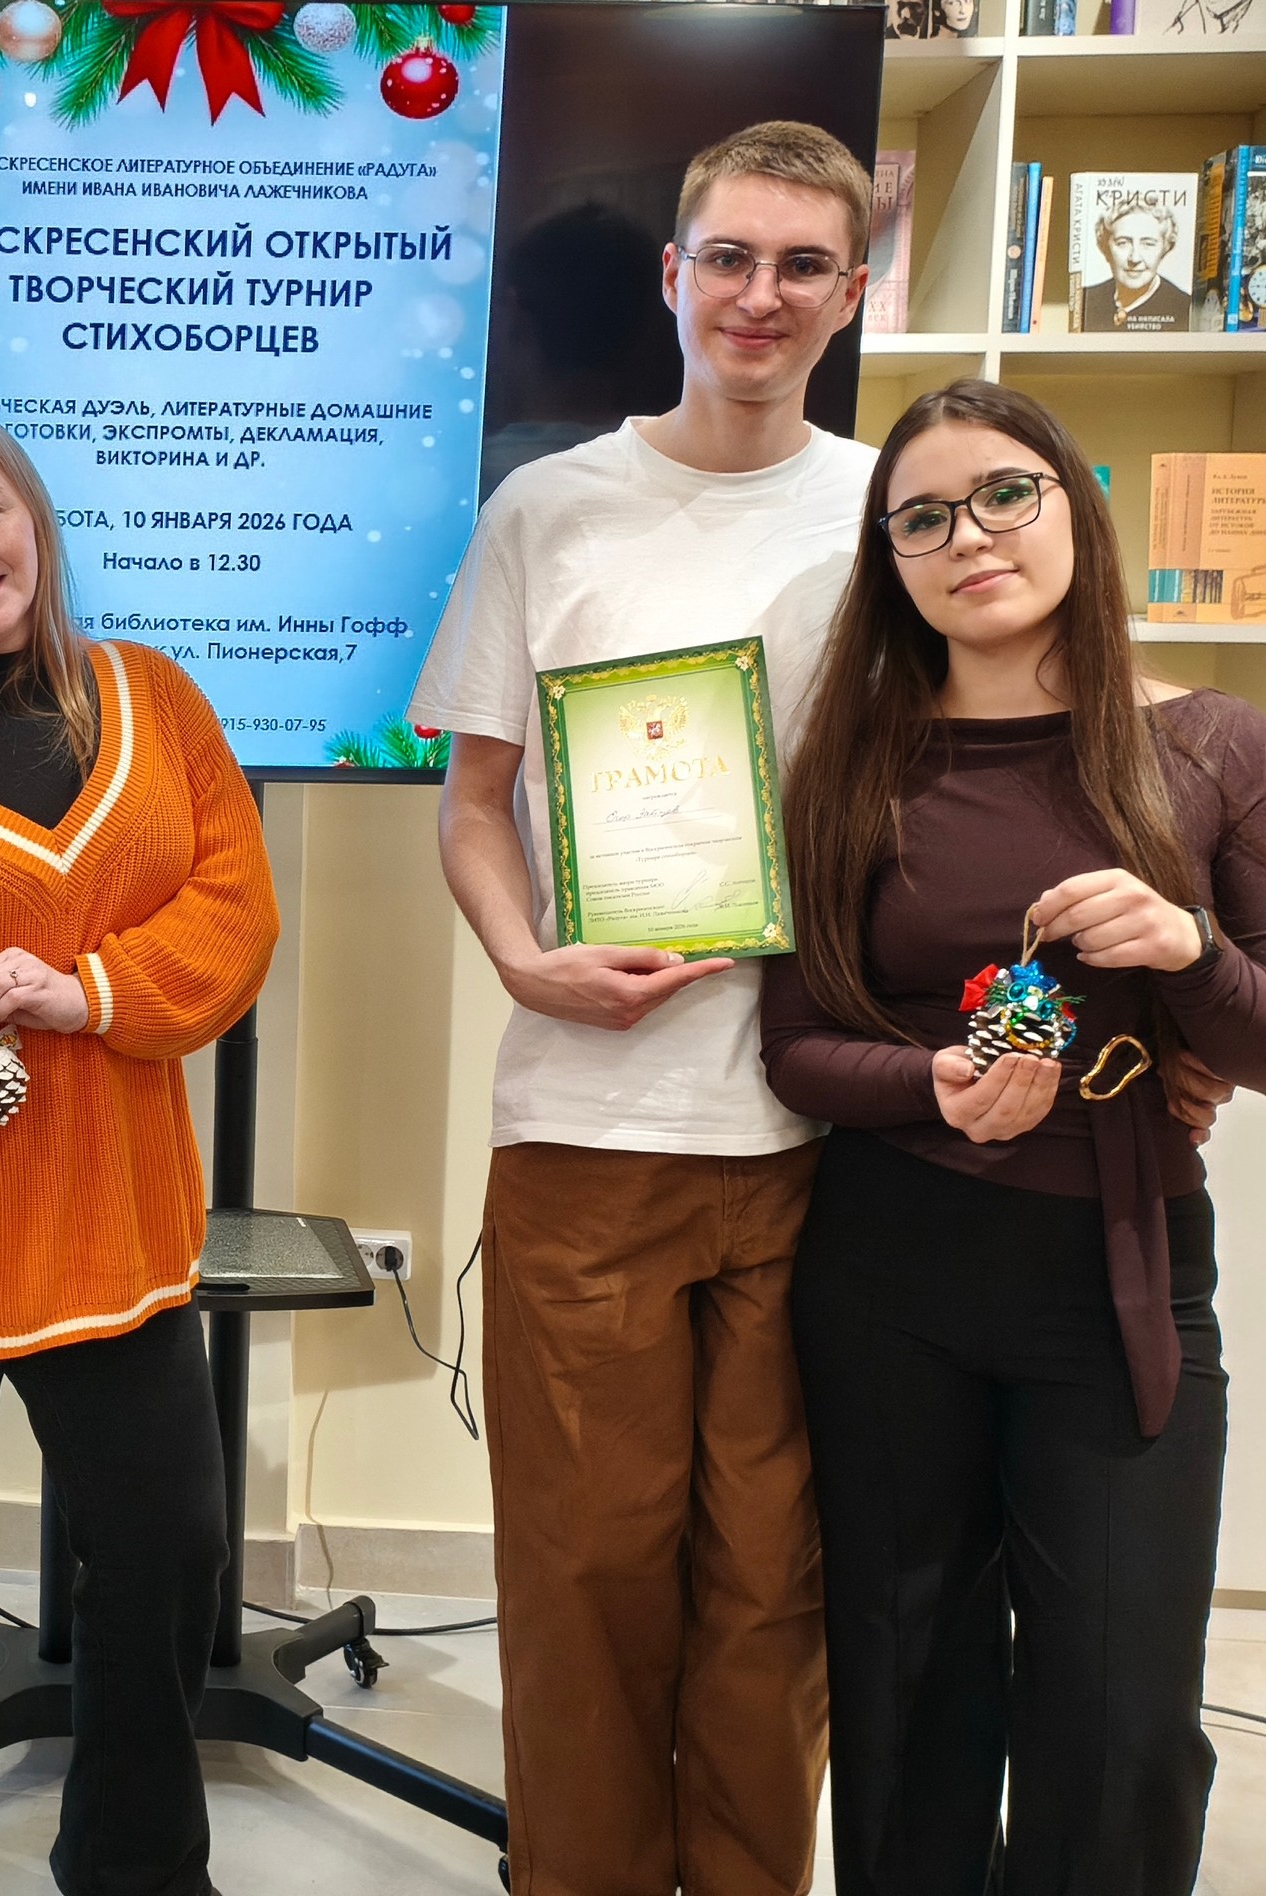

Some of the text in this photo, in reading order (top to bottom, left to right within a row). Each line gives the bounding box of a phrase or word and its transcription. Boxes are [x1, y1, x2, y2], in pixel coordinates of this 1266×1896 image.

[115, 157, 235, 175] ЛИТЕРАТУРНОЕ
[239, 159, 355, 179] ОБЪЕДИНЕНИЕ
[358, 161, 437, 180] «РАДУГА»
[22, 180, 368, 200] ИМЕНИ ИВАНА ИВАНОВИЧА ЛАЖЕЧНИКОВА
[1074, 183, 1083, 216] АГАТА
[1096, 189, 1187, 207] КРИСТИ
[266, 225, 452, 261] ОТКРЫТЫЙ
[1072, 219, 1082, 265] КРИСТИ
[9, 269, 373, 308] ТВОРЧЕСКИЙ ТУРНИР
[62, 321, 319, 357] СТИХОБОРЦЕВ
[82, 399, 155, 418] ДУЭЛЬ,
[160, 400, 307, 418] ЛИТЕРАТУРНЫЕ
[311, 402, 433, 422] ДОМАШНИЕ
[6, 423, 385, 447] ГОТОВКИ, ЭКСПРОМТЫ, ДЕКЛАМАЦИЯ,
[96, 450, 266, 471] ВИКТОРИНА И ДР.
[57, 510, 353, 534] БОТА, 10 ЯНВАРЯ 2026 ГОДА
[103, 552, 261, 571] Начало в 12.30
[102, 613, 230, 631] библиотека
[237, 619, 270, 632] им.
[278, 615, 334, 633] Инны
[340, 617, 409, 637] Гофф
[173, 643, 358, 664] ул. Пионерская,7
[221, 717, 327, 732] 915-930-07-95
[590, 755, 733, 793] ГРАМОТА
